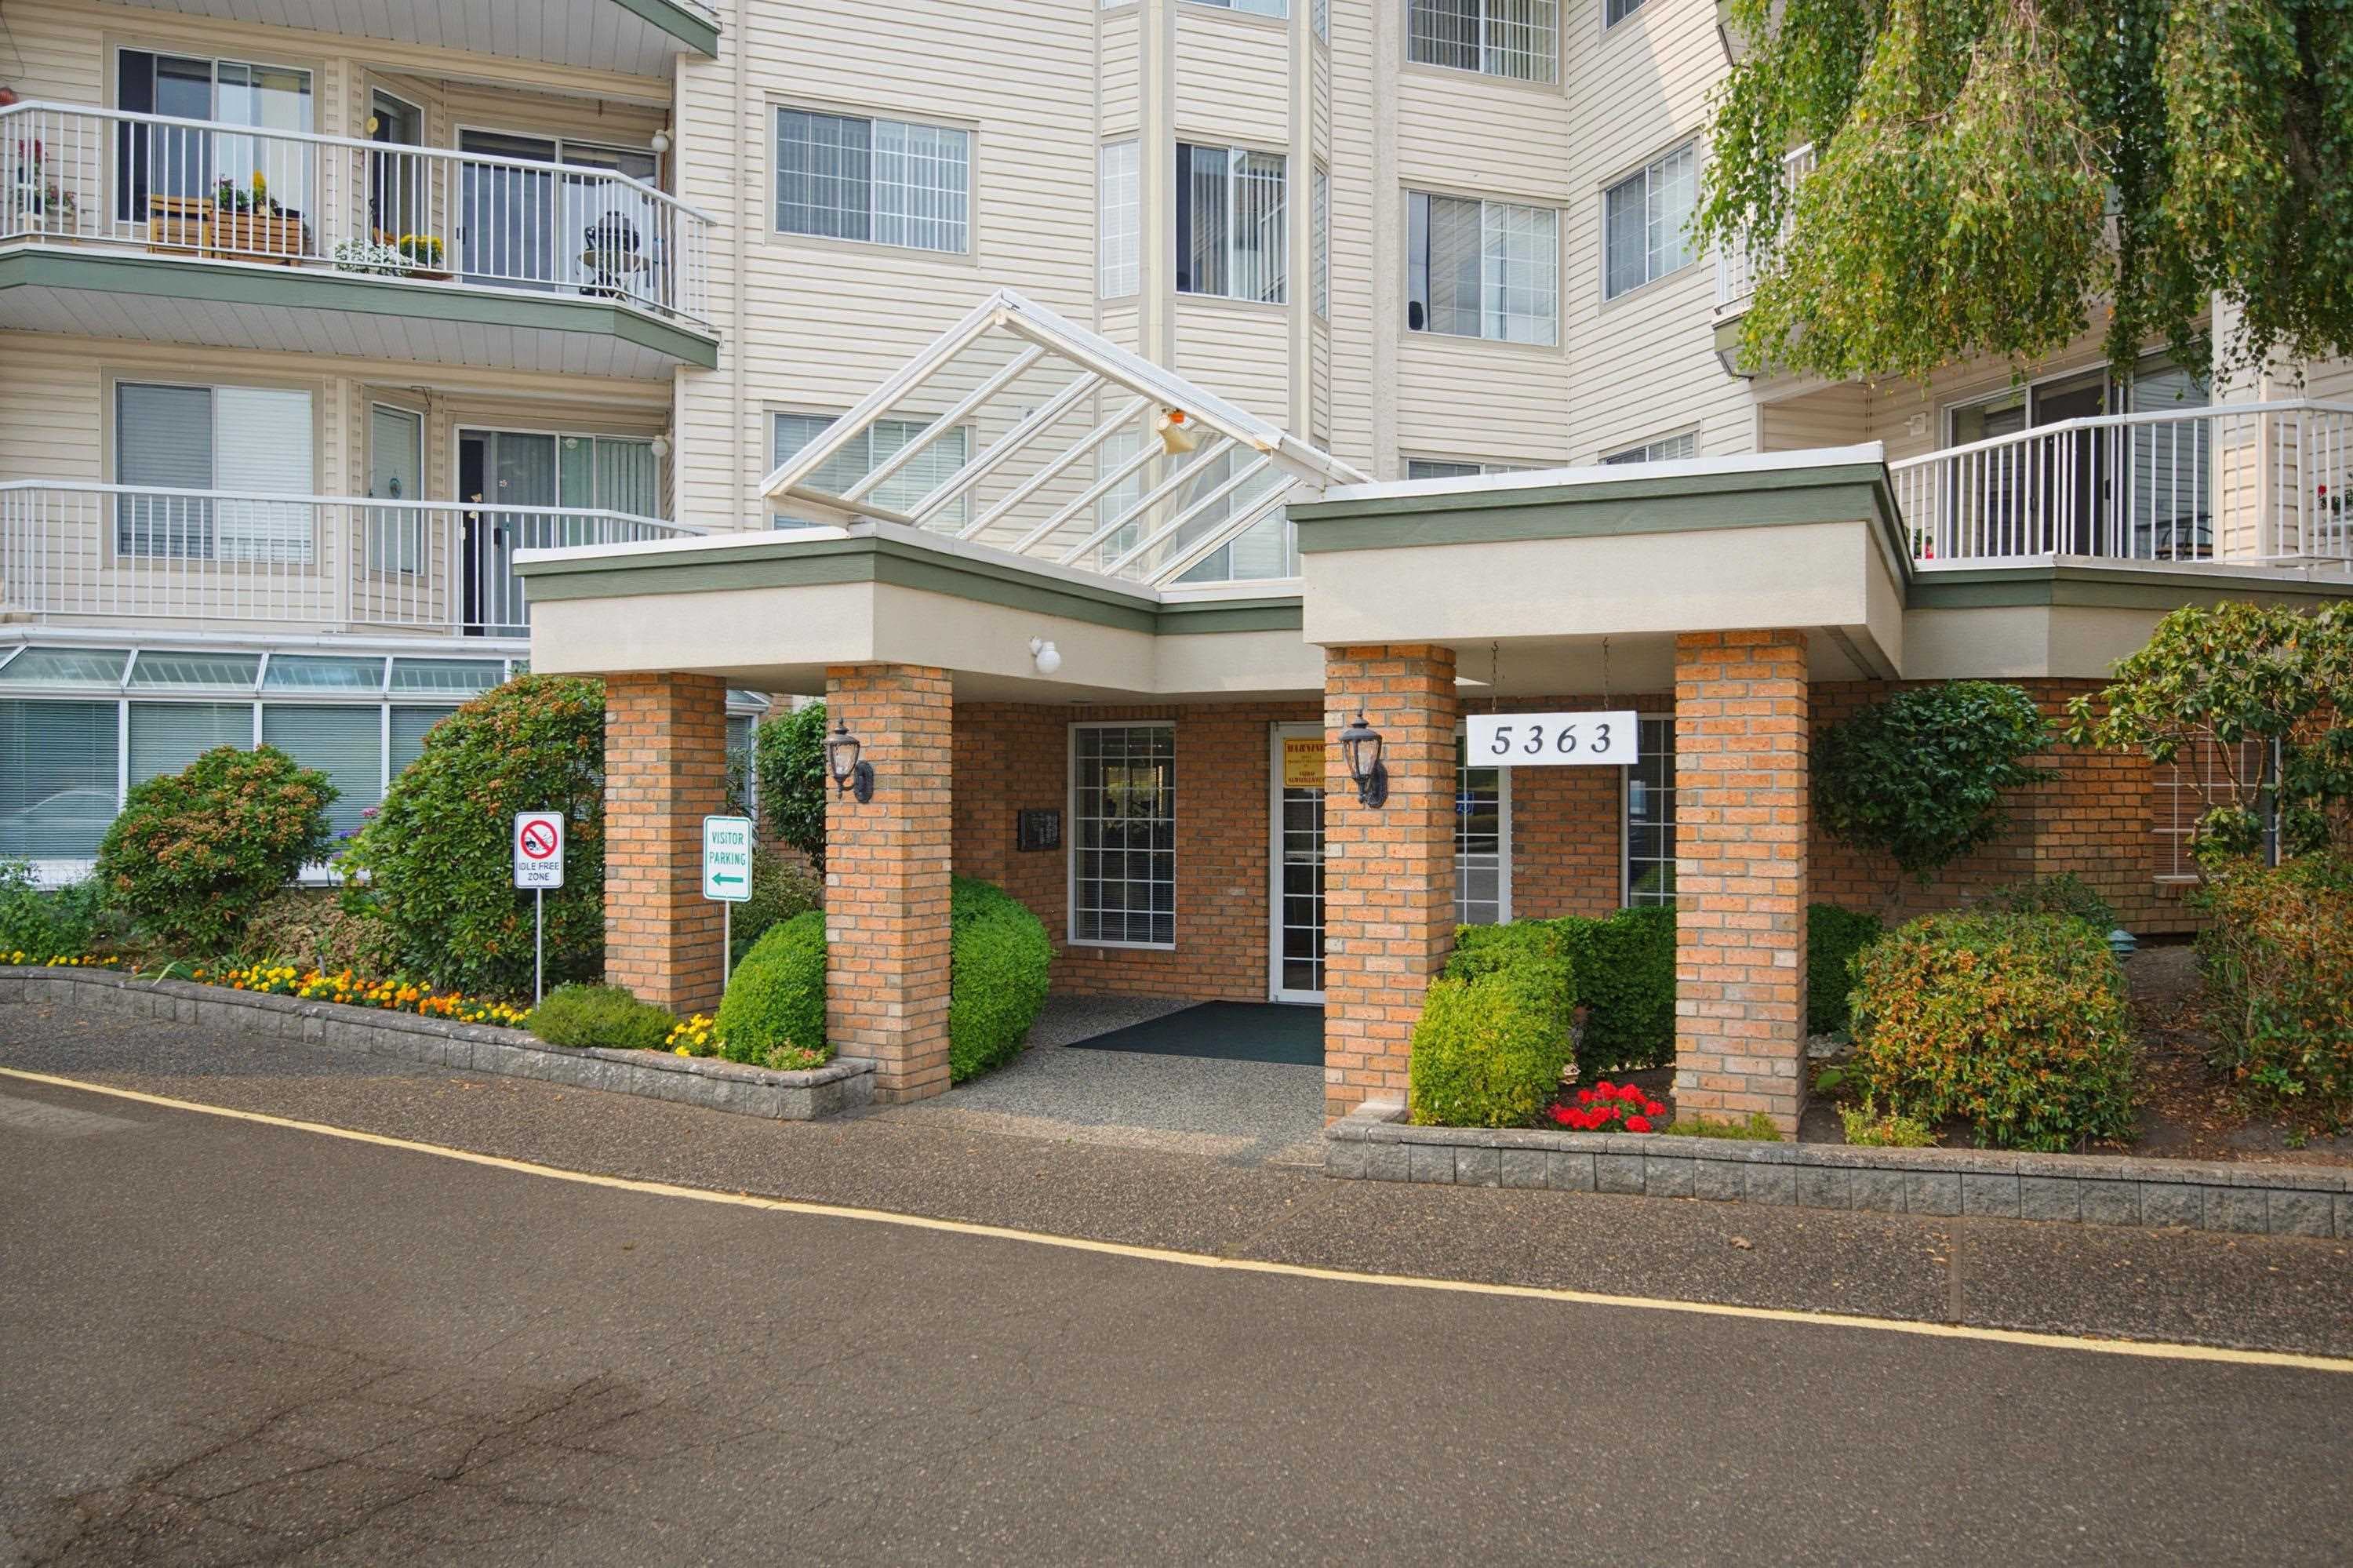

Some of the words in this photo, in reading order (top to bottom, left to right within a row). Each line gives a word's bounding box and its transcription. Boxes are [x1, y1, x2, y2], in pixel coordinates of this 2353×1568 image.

[1491, 723, 1611, 755] 5363
[712, 831, 744, 845] VISITOR
[709, 851, 746, 866] PARKING
[528, 872, 550, 881] ZONE
